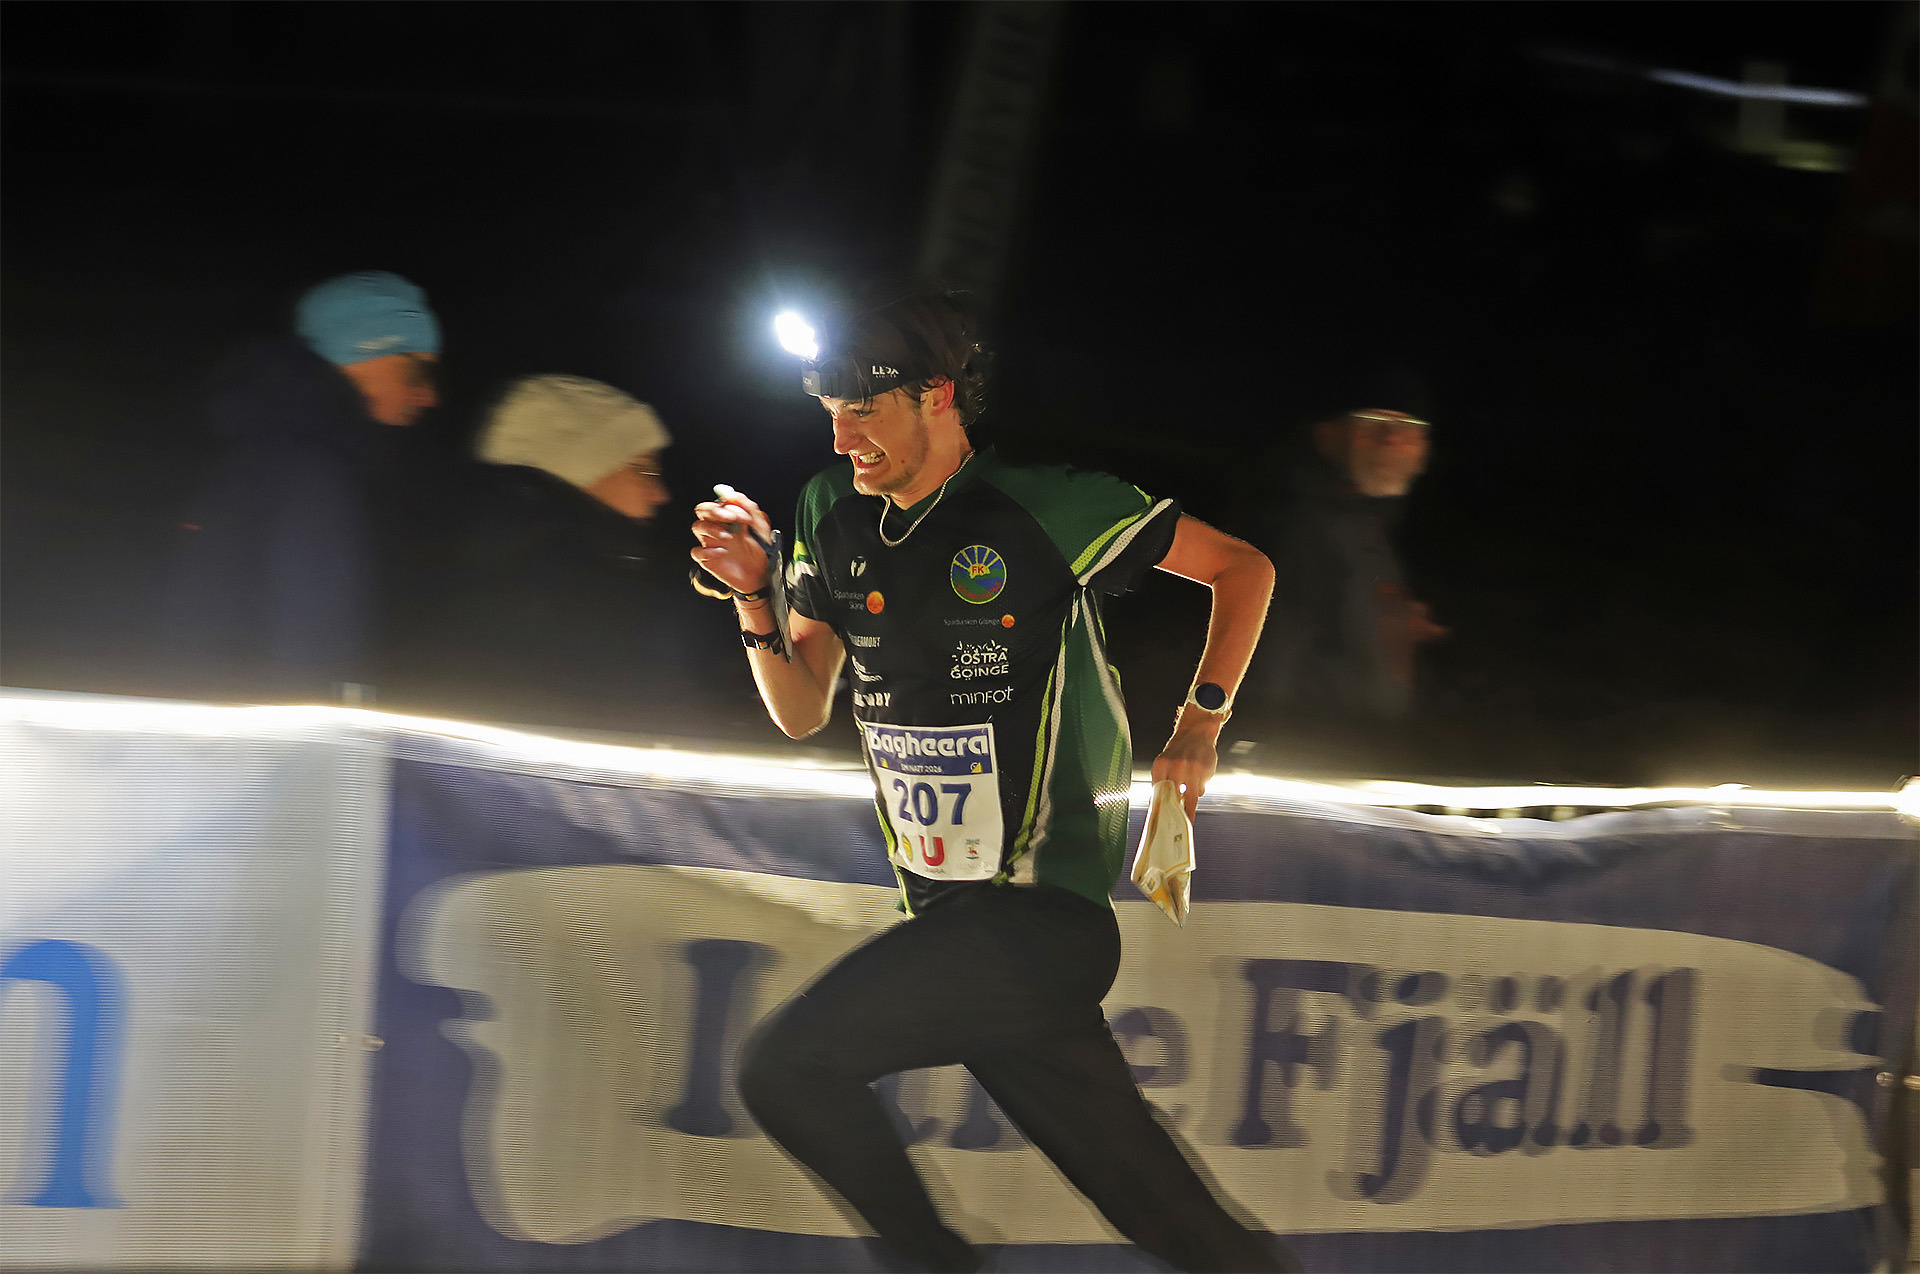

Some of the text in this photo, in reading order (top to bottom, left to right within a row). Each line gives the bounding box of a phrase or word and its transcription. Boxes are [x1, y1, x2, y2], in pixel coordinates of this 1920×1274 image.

[972, 566, 985, 574] FK
[868, 729, 989, 759] bagheera
[893, 778, 972, 826] 207
